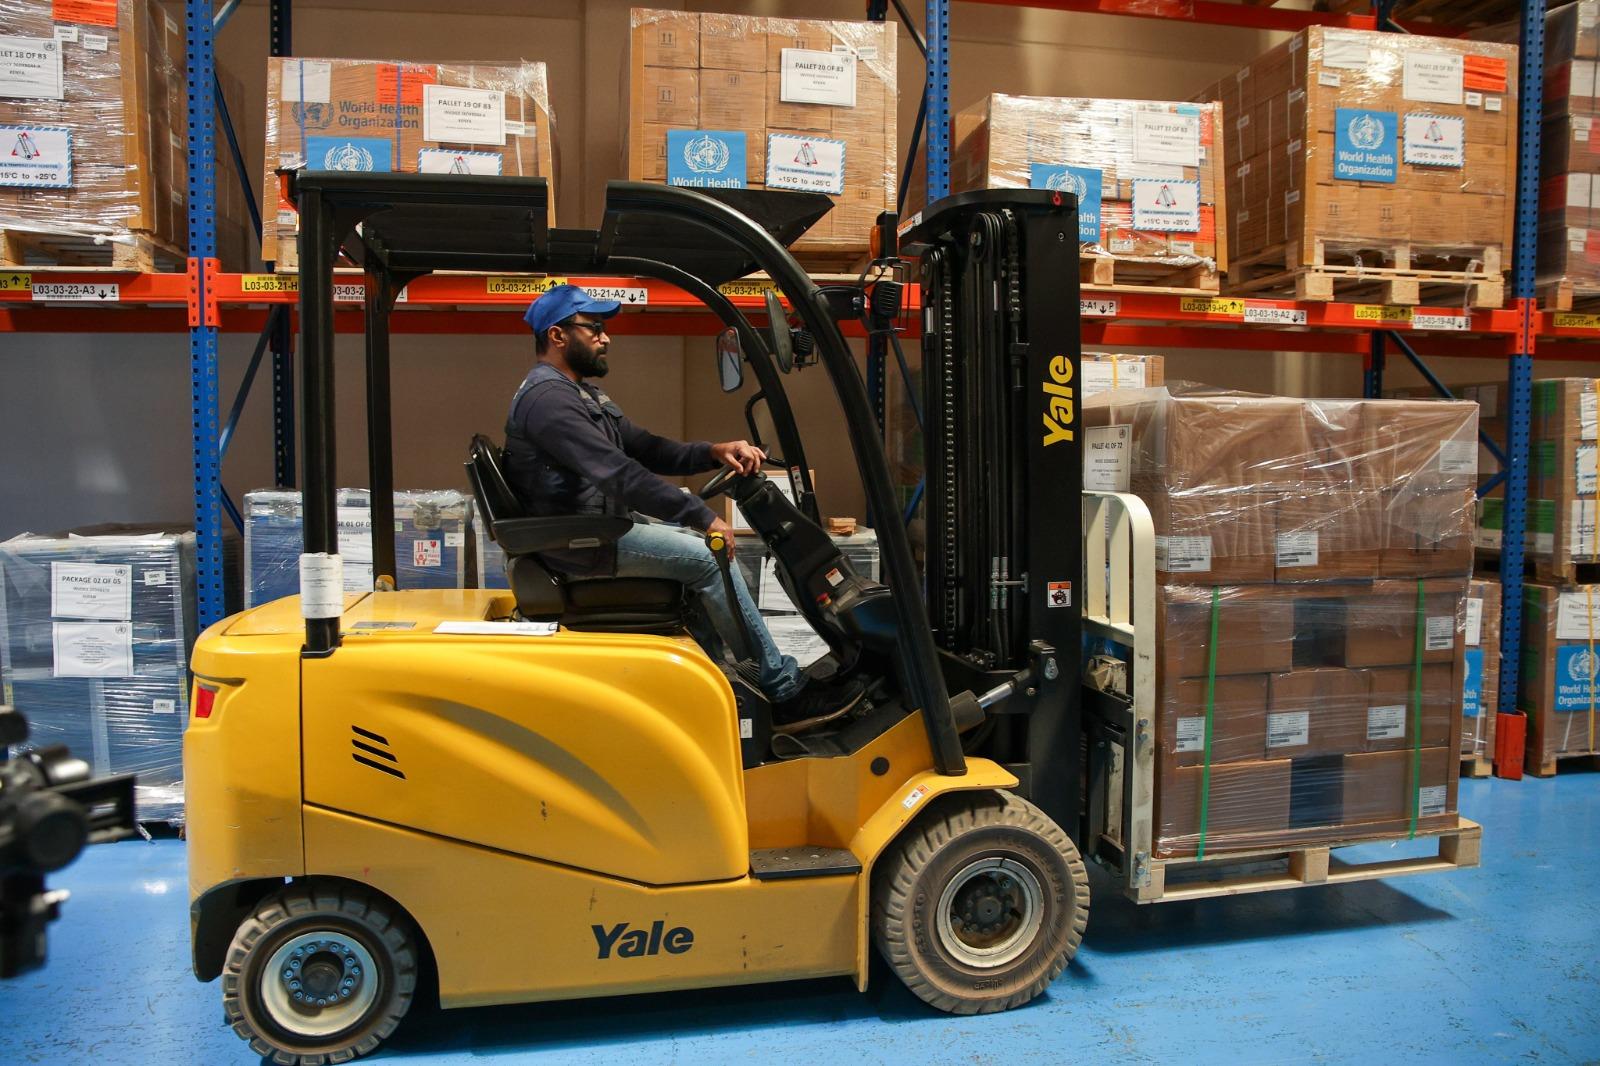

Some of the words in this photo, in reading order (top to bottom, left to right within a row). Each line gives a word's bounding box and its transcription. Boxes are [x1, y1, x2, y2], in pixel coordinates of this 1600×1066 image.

[795, 62, 817, 70] PALLET
[339, 100, 375, 113] World
[438, 99, 461, 107] PALLET
[1339, 151, 1364, 163] World
[1366, 153, 1393, 164] Health
[1338, 162, 1393, 176] Organization
[672, 177, 704, 188] World
[707, 178, 741, 188] Health
[32, 285, 96, 294] L03-03-23-A3
[110, 285, 116, 294] 4
[244, 281, 298, 291] L03-03-21-H
[489, 283, 547, 293] L03-03-21-H2
[722, 286, 771, 295] 03-03-21-H
[639, 290, 645, 298] A
[1108, 302, 1114, 310] P
[1182, 302, 1228, 313] L03-03-19-H2
[1244, 309, 1290, 319] L03-03-19-A2
[1042, 355, 1074, 447] Yale
[62, 575, 92, 584] PACKAGE
[1559, 684, 1581, 694] World
[591, 920, 694, 959] Yale
